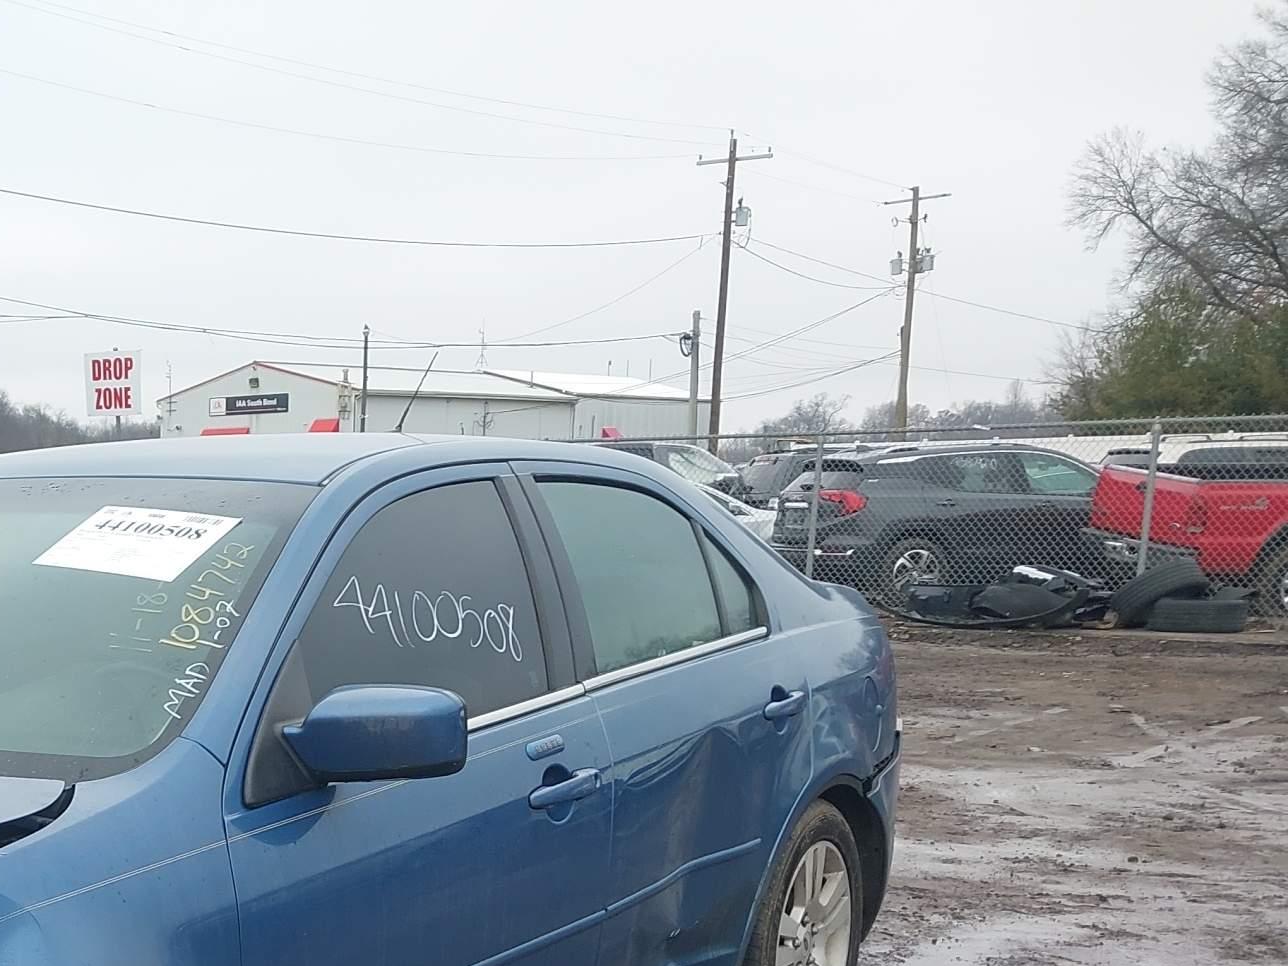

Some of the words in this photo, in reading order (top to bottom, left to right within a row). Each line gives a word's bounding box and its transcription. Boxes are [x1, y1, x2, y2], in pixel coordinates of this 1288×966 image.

[91, 357, 133, 381] DROP
[95, 386, 132, 410] ZONE
[95, 519, 208, 541] 44100508
[158, 542, 255, 649] 1084742
[333, 576, 523, 662] 44100508
[163, 662, 210, 720] MAD
